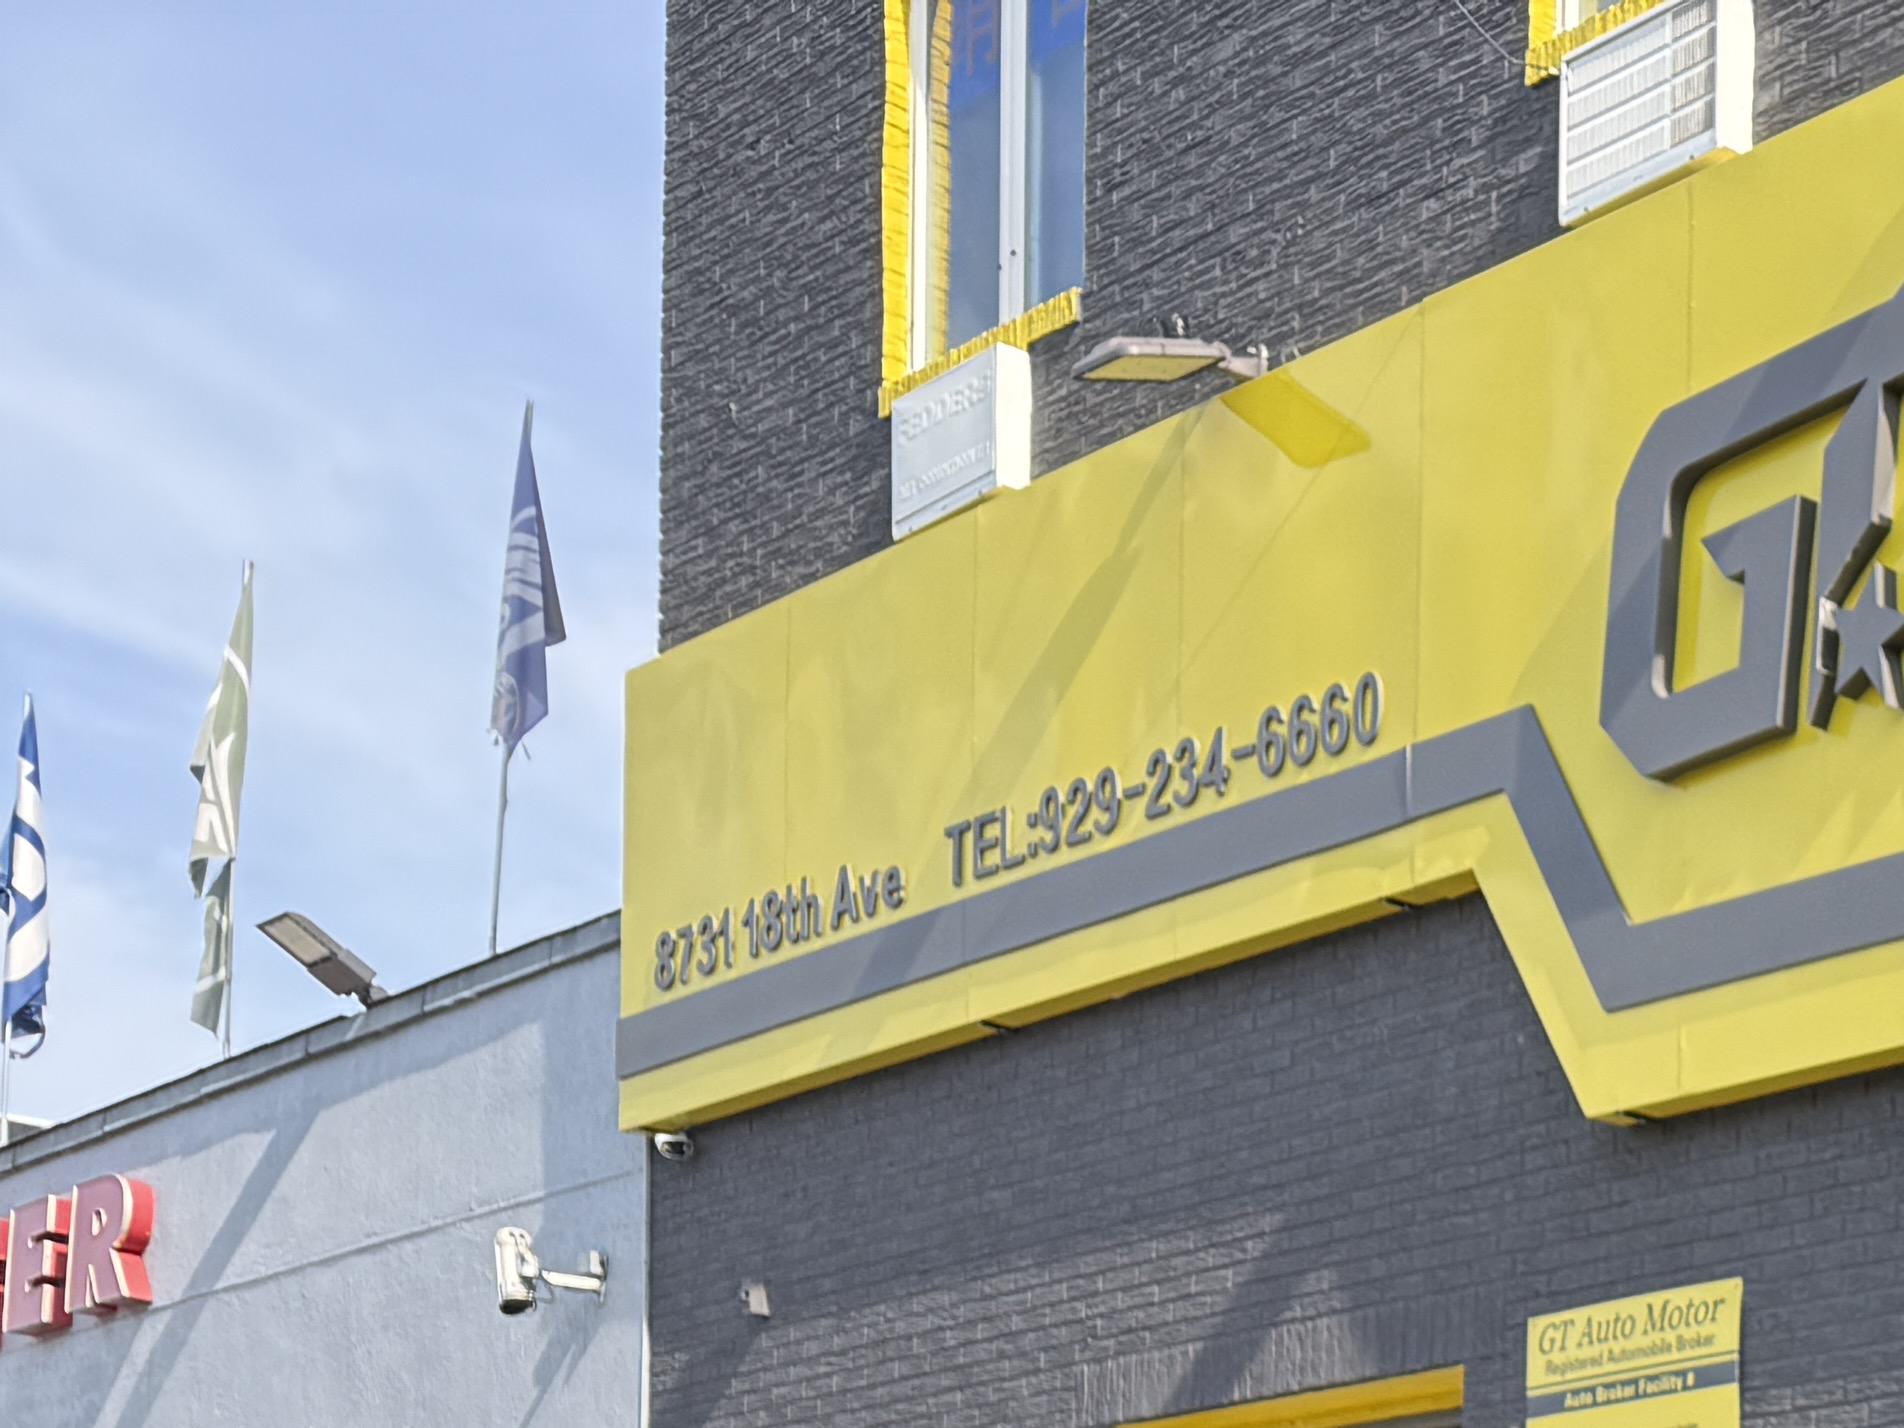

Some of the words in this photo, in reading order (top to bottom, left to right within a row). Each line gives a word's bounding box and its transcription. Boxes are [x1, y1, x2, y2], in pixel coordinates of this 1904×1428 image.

[653, 906, 733, 991] 8731
[741, 874, 823, 959] 18th
[831, 863, 905, 929] Ave
[945, 671, 1384, 886] TEL:929-234-6660
[0, 1173, 155, 1335] ER
[1539, 1319, 1574, 1357] GT
[1577, 1315, 1637, 1349] Auto
[1643, 1297, 1727, 1336] Motor
